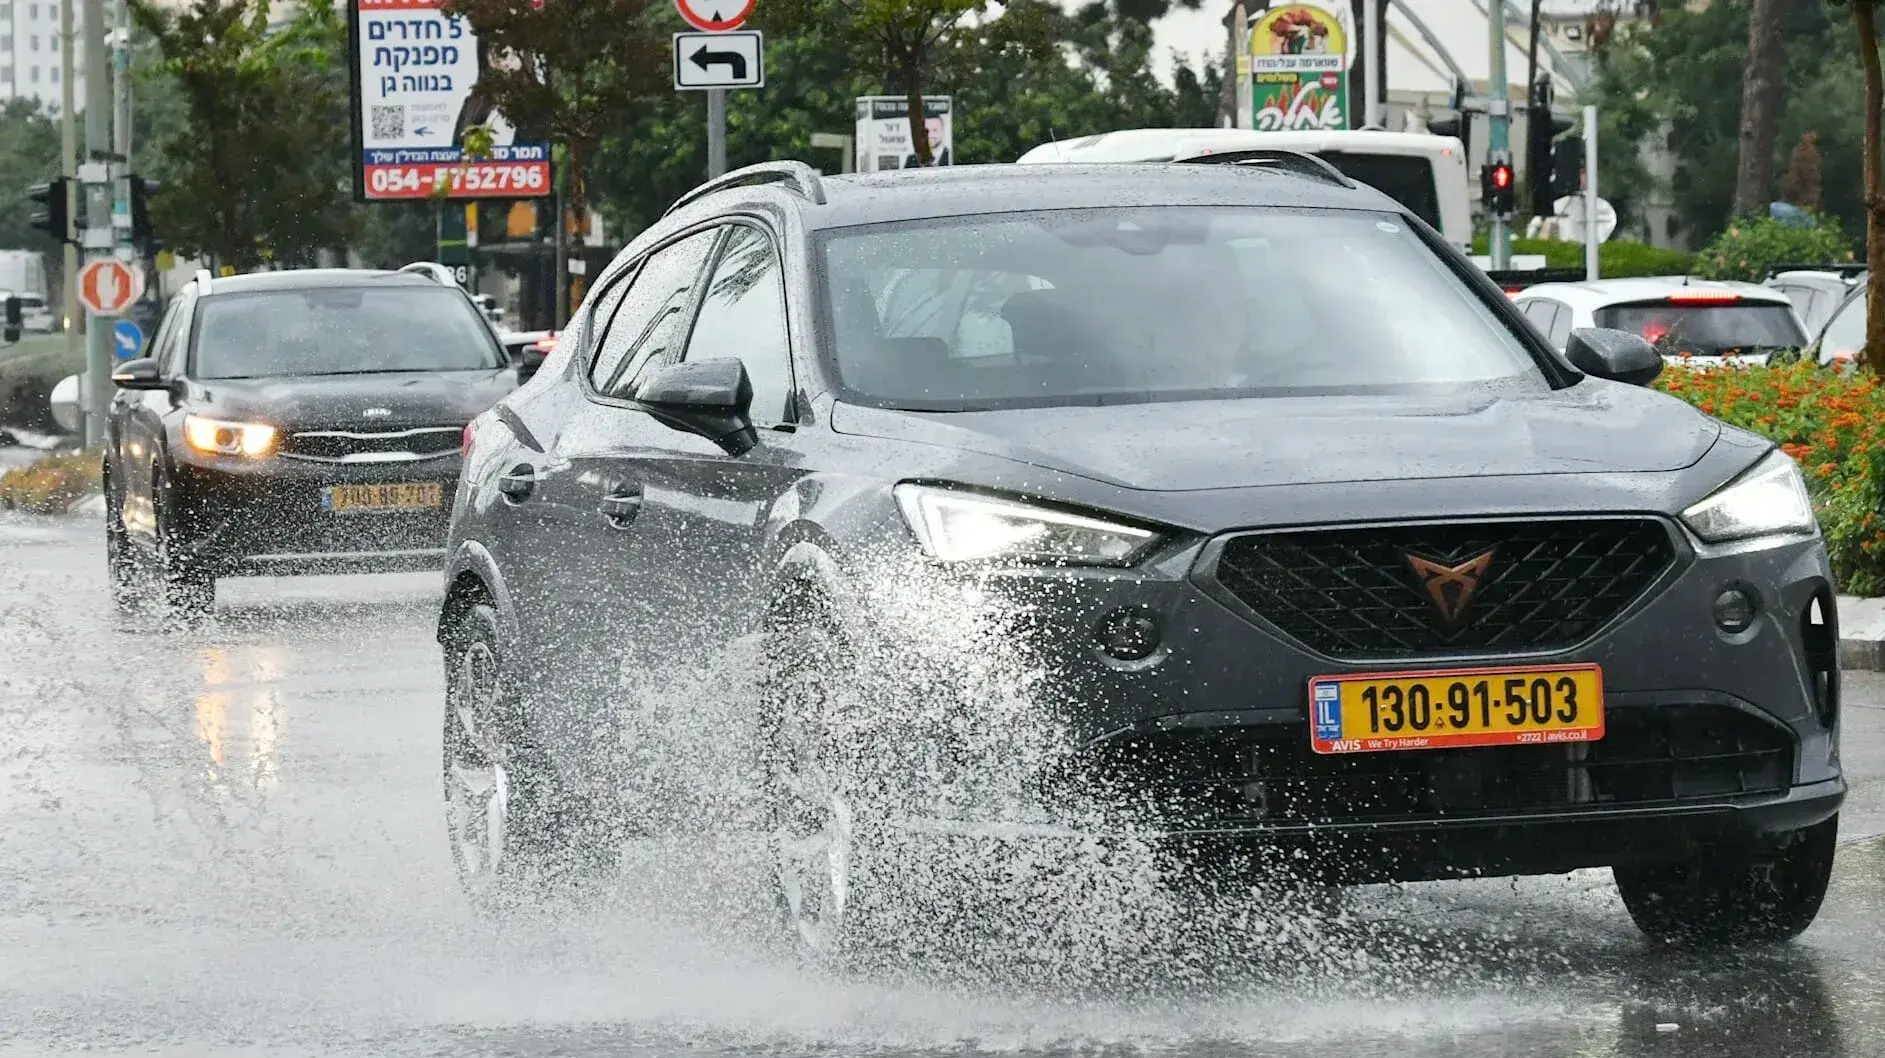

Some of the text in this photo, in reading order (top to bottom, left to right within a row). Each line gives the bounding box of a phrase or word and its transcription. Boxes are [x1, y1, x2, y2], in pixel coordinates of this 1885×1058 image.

[368, 17, 462, 40] 5 חדרים
[373, 46, 458, 73] מפנקת
[381, 75, 453, 98] בנווה גן
[371, 151, 394, 165] שלך
[371, 165, 543, 192] 054-5752796
[1318, 701, 1336, 725] IL
[1332, 740, 1361, 751] AVIS
[1368, 738, 1429, 749] We Try Harder
[1547, 729, 1588, 742] avis.co.il
